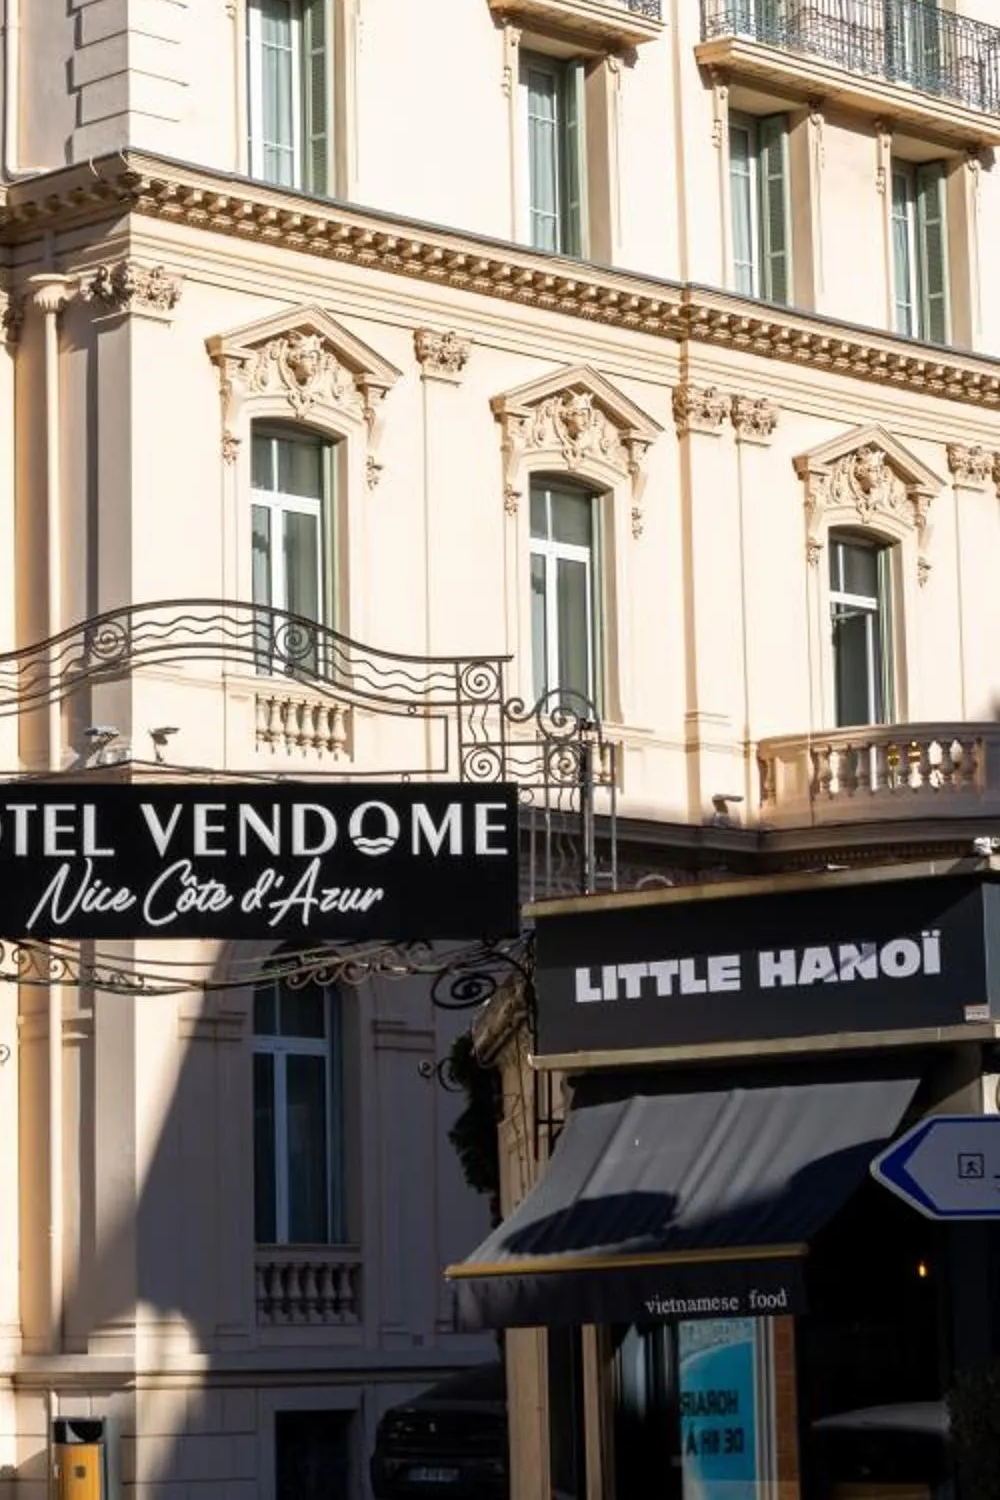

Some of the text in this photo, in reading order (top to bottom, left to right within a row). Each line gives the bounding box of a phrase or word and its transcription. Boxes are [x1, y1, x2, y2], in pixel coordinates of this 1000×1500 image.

[139, 801, 509, 858] VENDOME
[25, 856, 384, 931] Nice Côte d'Azur
[575, 930, 942, 1003] LITTLE HANOÏ
[645, 1287, 788, 1315] vietnamese food
